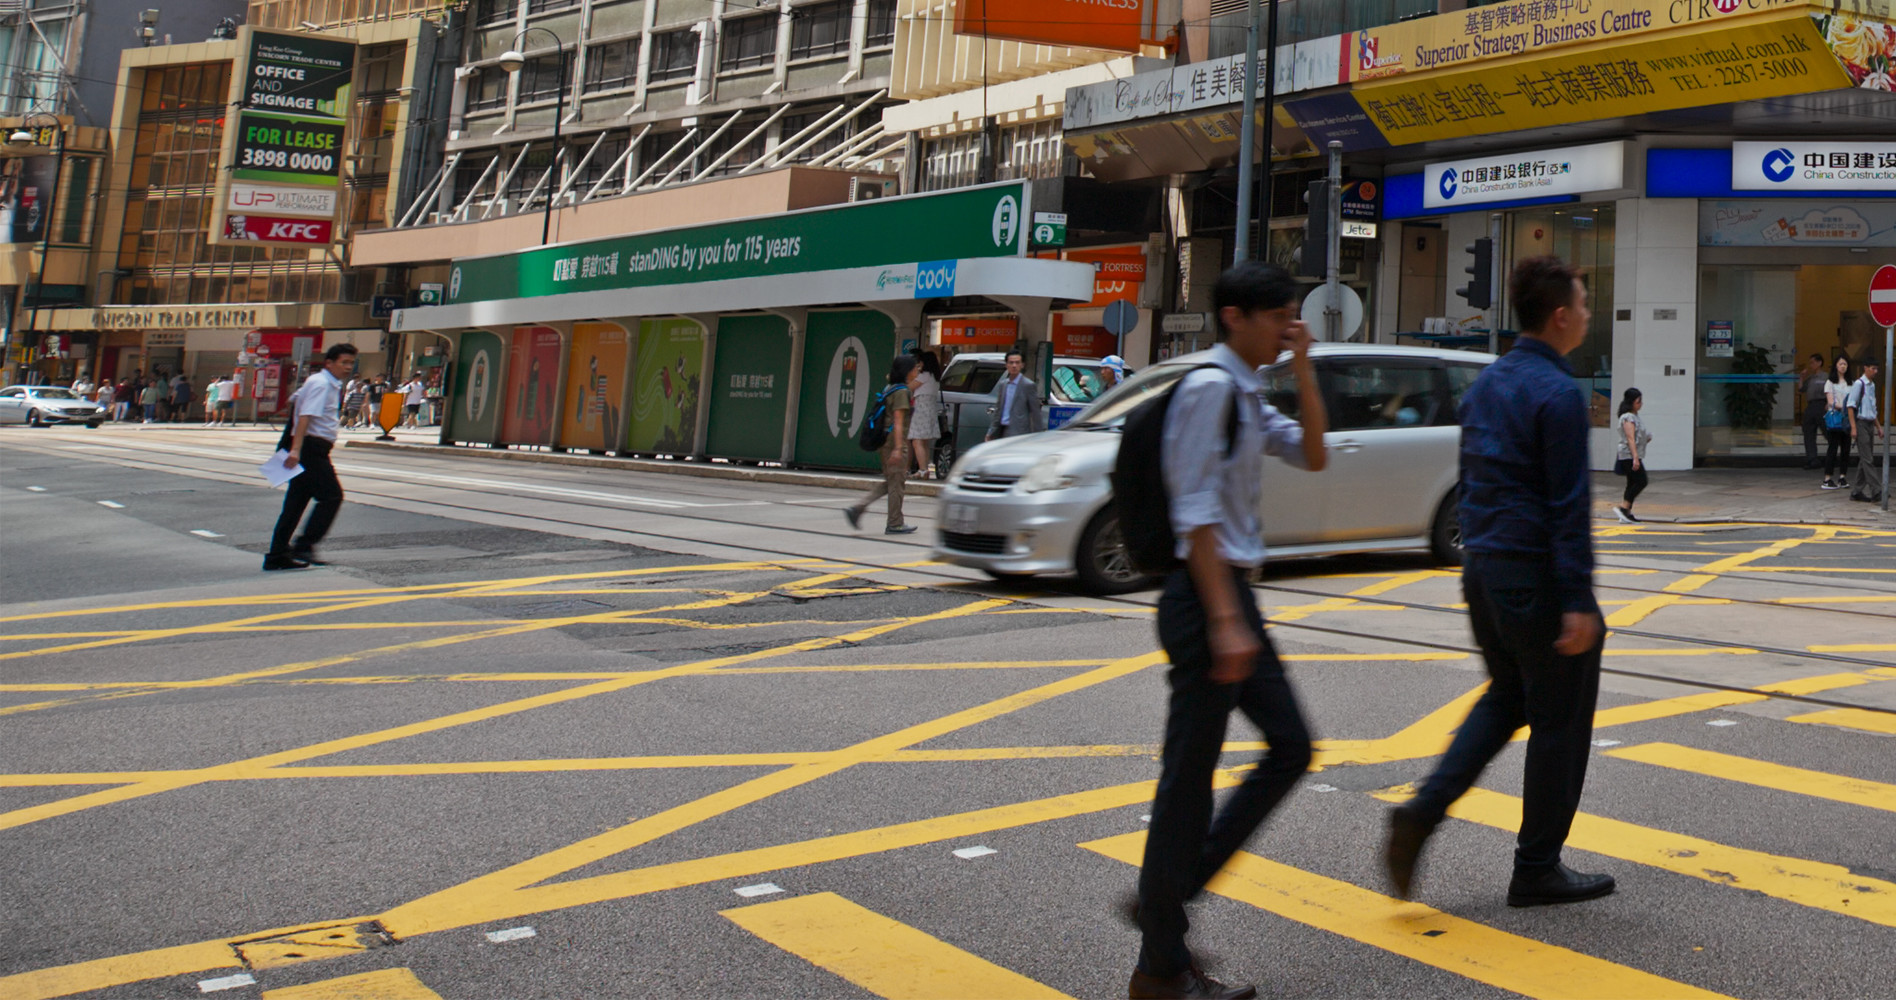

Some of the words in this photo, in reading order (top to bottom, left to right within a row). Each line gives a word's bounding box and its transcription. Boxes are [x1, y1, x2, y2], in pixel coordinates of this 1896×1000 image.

[1415, 38, 1470, 69] Superior
[1472, 30, 1529, 60] Strategy
[1533, 17, 1597, 47] Business
[1601, 8, 1652, 35] Centre
[257, 52, 290, 61] UNICORN
[292, 55, 313, 64] TRADE
[315, 58, 341, 67] CENTER
[1646, 33, 1811, 73] www.virtual.com.hk
[255, 65, 305, 81] OFFICE
[1715, 57, 1808, 86] 2287-5000
[253, 79, 282, 92] AND
[251, 93, 314, 110] SIGNAGE
[247, 126, 281, 146] FOR
[285, 130, 335, 150] LEASE
[242, 148, 286, 167] 3898
[290, 153, 333, 171] 0000
[1803, 169, 1834, 180] China
[1462, 183, 1478, 194] China
[1480, 180, 1517, 193] Construction
[1518, 178, 1534, 189] Bank
[1535, 177, 1553, 188] (Asia)
[275, 202, 329, 212] PERFORMANCE
[277, 192, 330, 206] ULTIMATE
[268, 222, 320, 239] KFC
[629, 245, 680, 273] stanDING
[681, 243, 698, 271] by
[698, 242, 720, 270] you
[723, 238, 742, 263] for
[744, 235, 762, 260] 115
[765, 236, 801, 264] years
[1104, 263, 1143, 273] FORTRESS
[917, 265, 955, 290] cody
[92, 311, 153, 328] UNICORN
[158, 310, 201, 327] TRADE
[205, 310, 256, 326] CENTRE
[977, 327, 1015, 337] FORTRESS
[840, 389, 854, 404] 115
